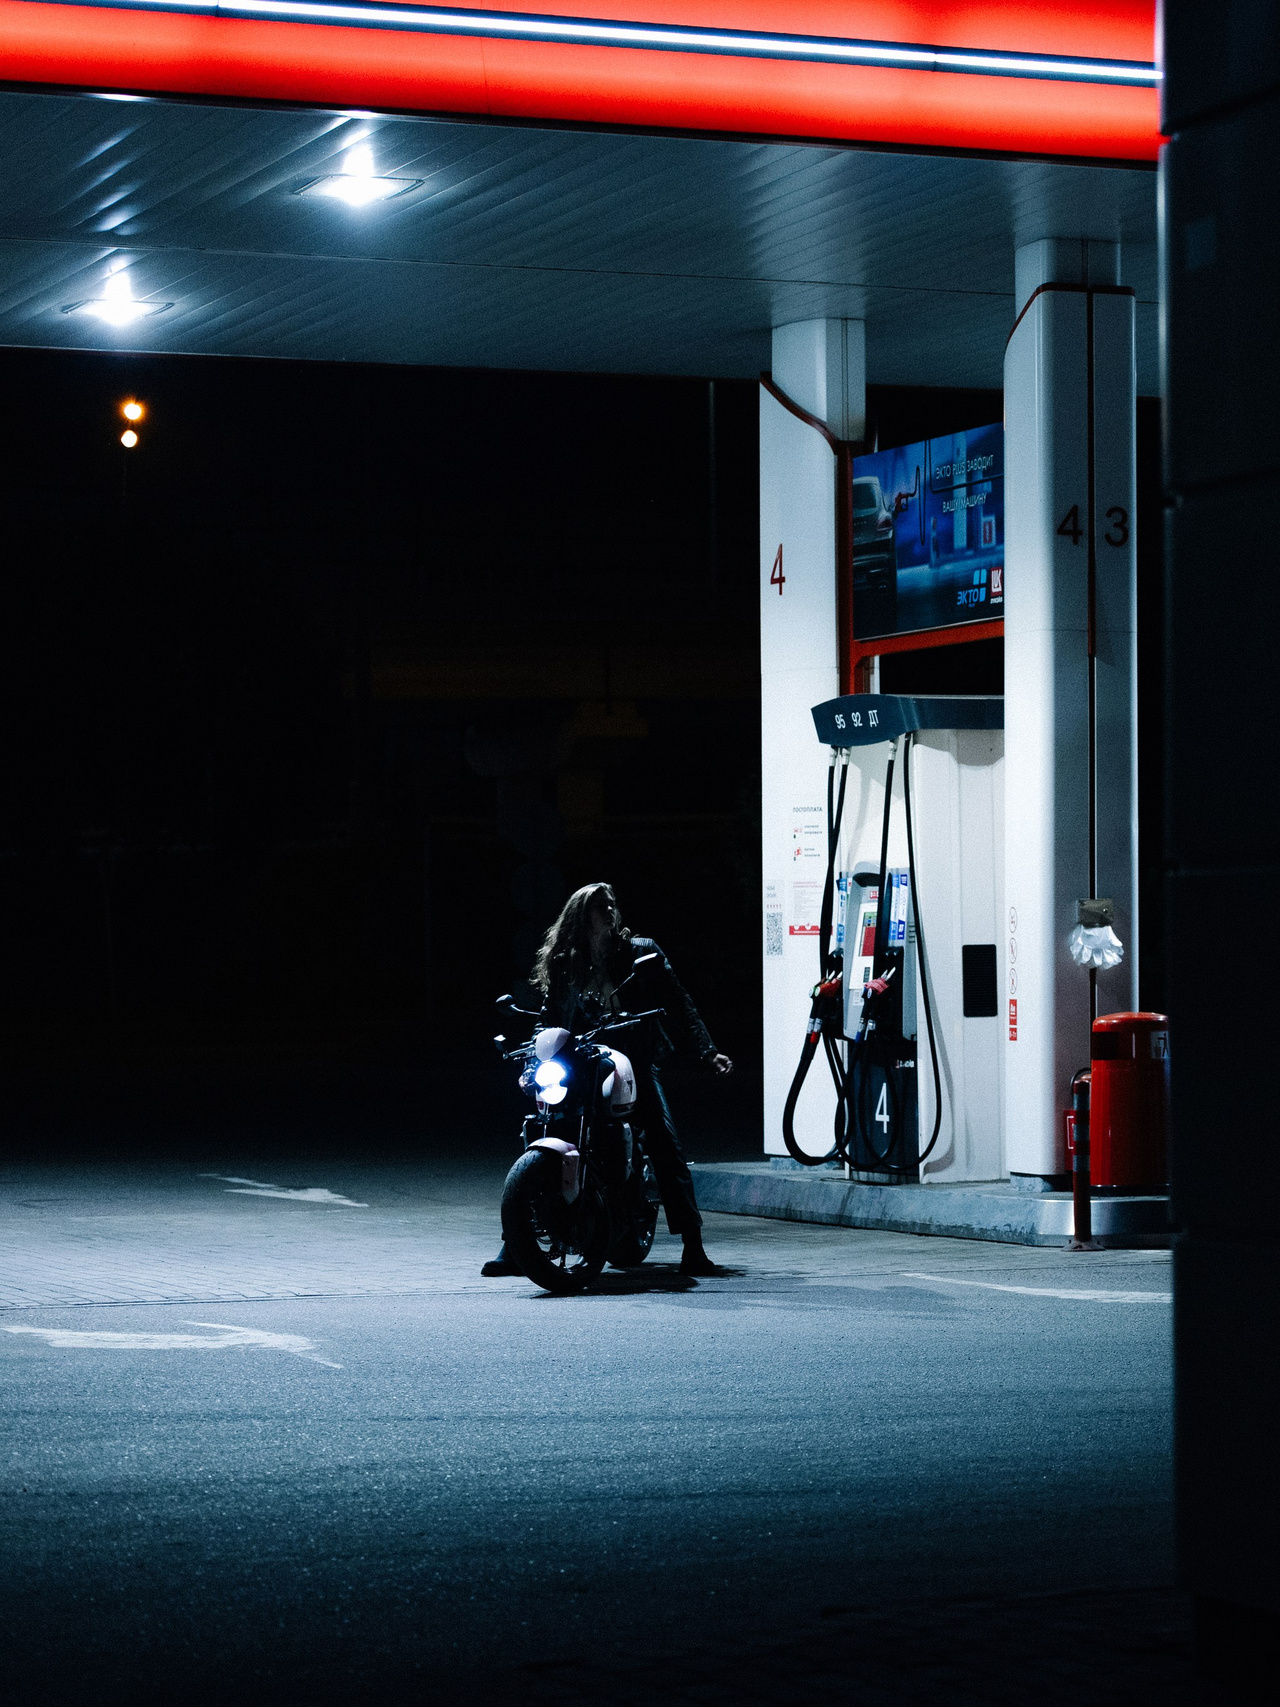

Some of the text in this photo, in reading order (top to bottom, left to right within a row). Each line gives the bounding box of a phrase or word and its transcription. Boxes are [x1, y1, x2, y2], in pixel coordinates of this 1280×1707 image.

[935, 454, 994, 479] ЭКТО PLUS ЗАВОДИТ
[942, 492, 987, 513] ВАШУ МАШИНУ
[1056, 504, 1129, 547] 4 3
[769, 543, 786, 596] 4
[956, 588, 979, 605] ЭКТО
[834, 709, 879, 729] 95 92 ДТ
[875, 1082, 890, 1134] 4
